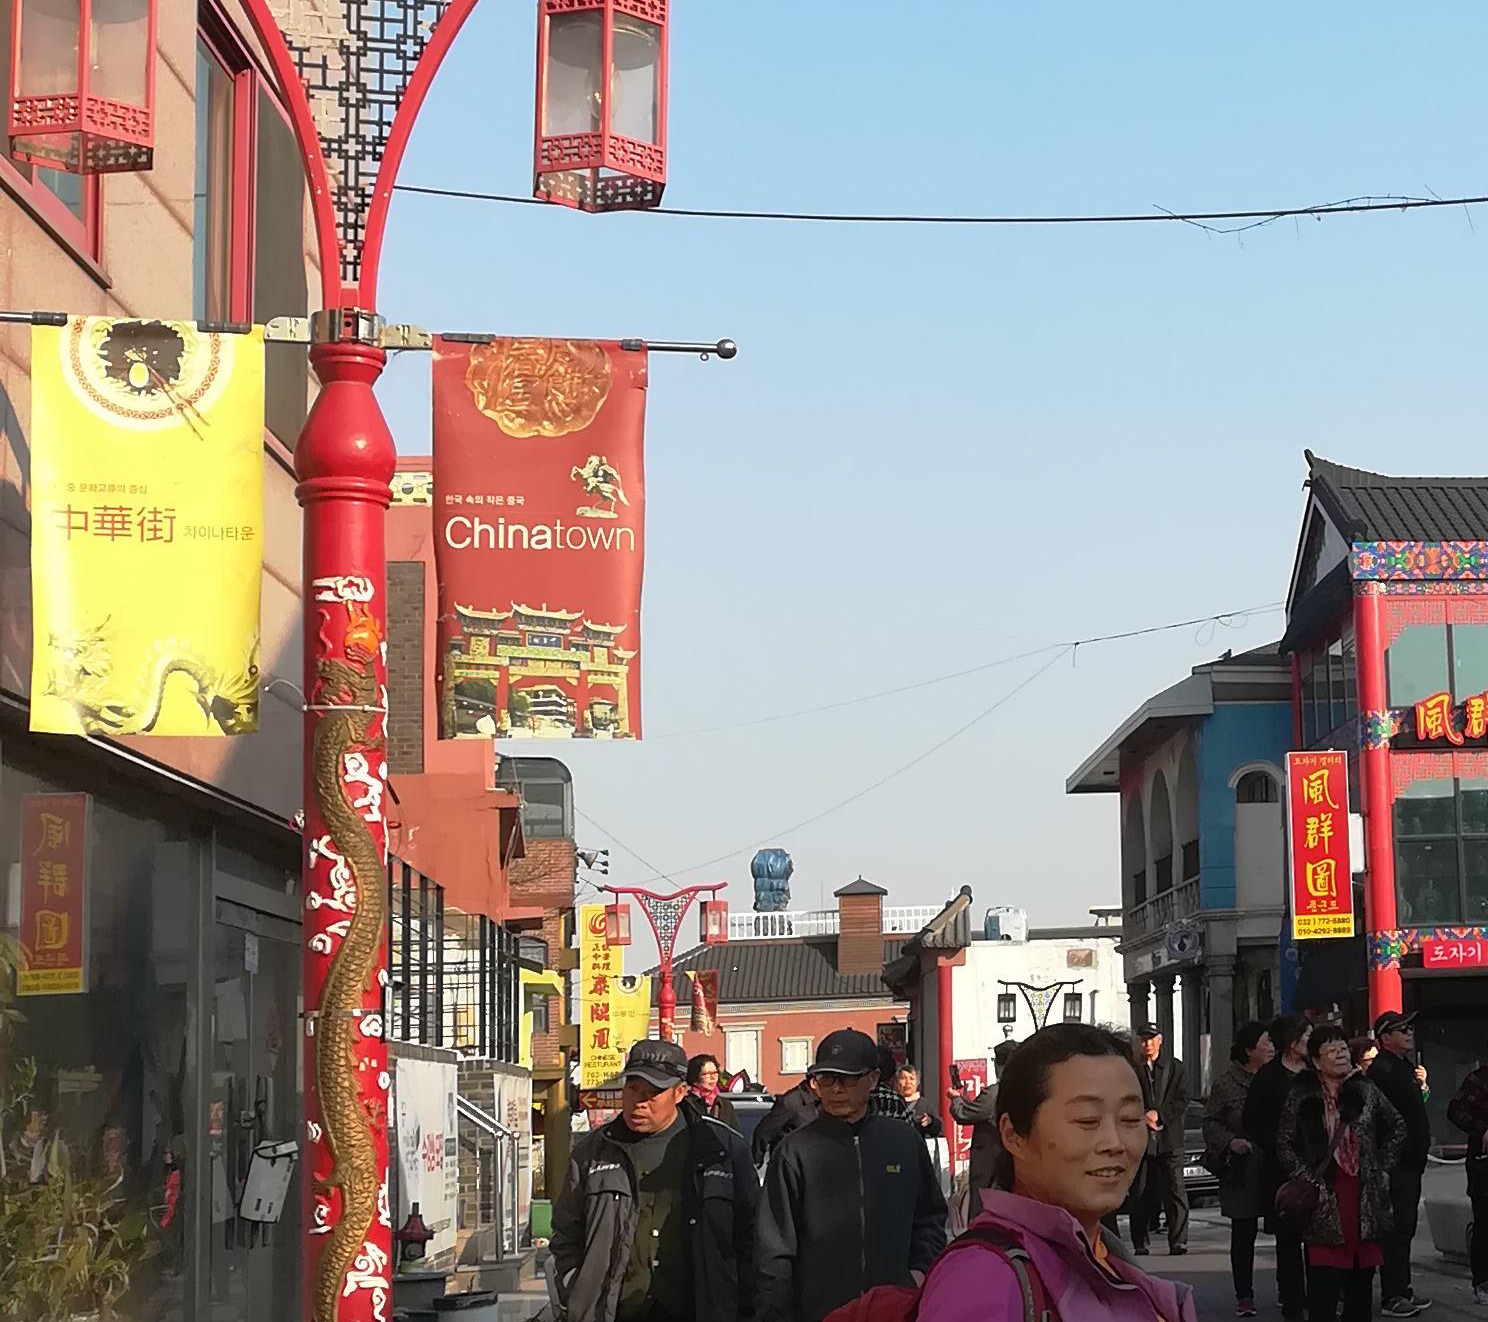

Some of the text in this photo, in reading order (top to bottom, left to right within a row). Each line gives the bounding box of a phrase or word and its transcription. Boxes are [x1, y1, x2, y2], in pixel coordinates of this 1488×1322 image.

[445, 494, 463, 506] 한국
[486, 494, 504, 506] 작은
[506, 495, 525, 506] 중국
[53, 504, 176, 543] 中華街
[183, 526, 255, 541] 차이나타운
[445, 516, 635, 552] Chinatown
[1430, 942, 1482, 963] 도자기
